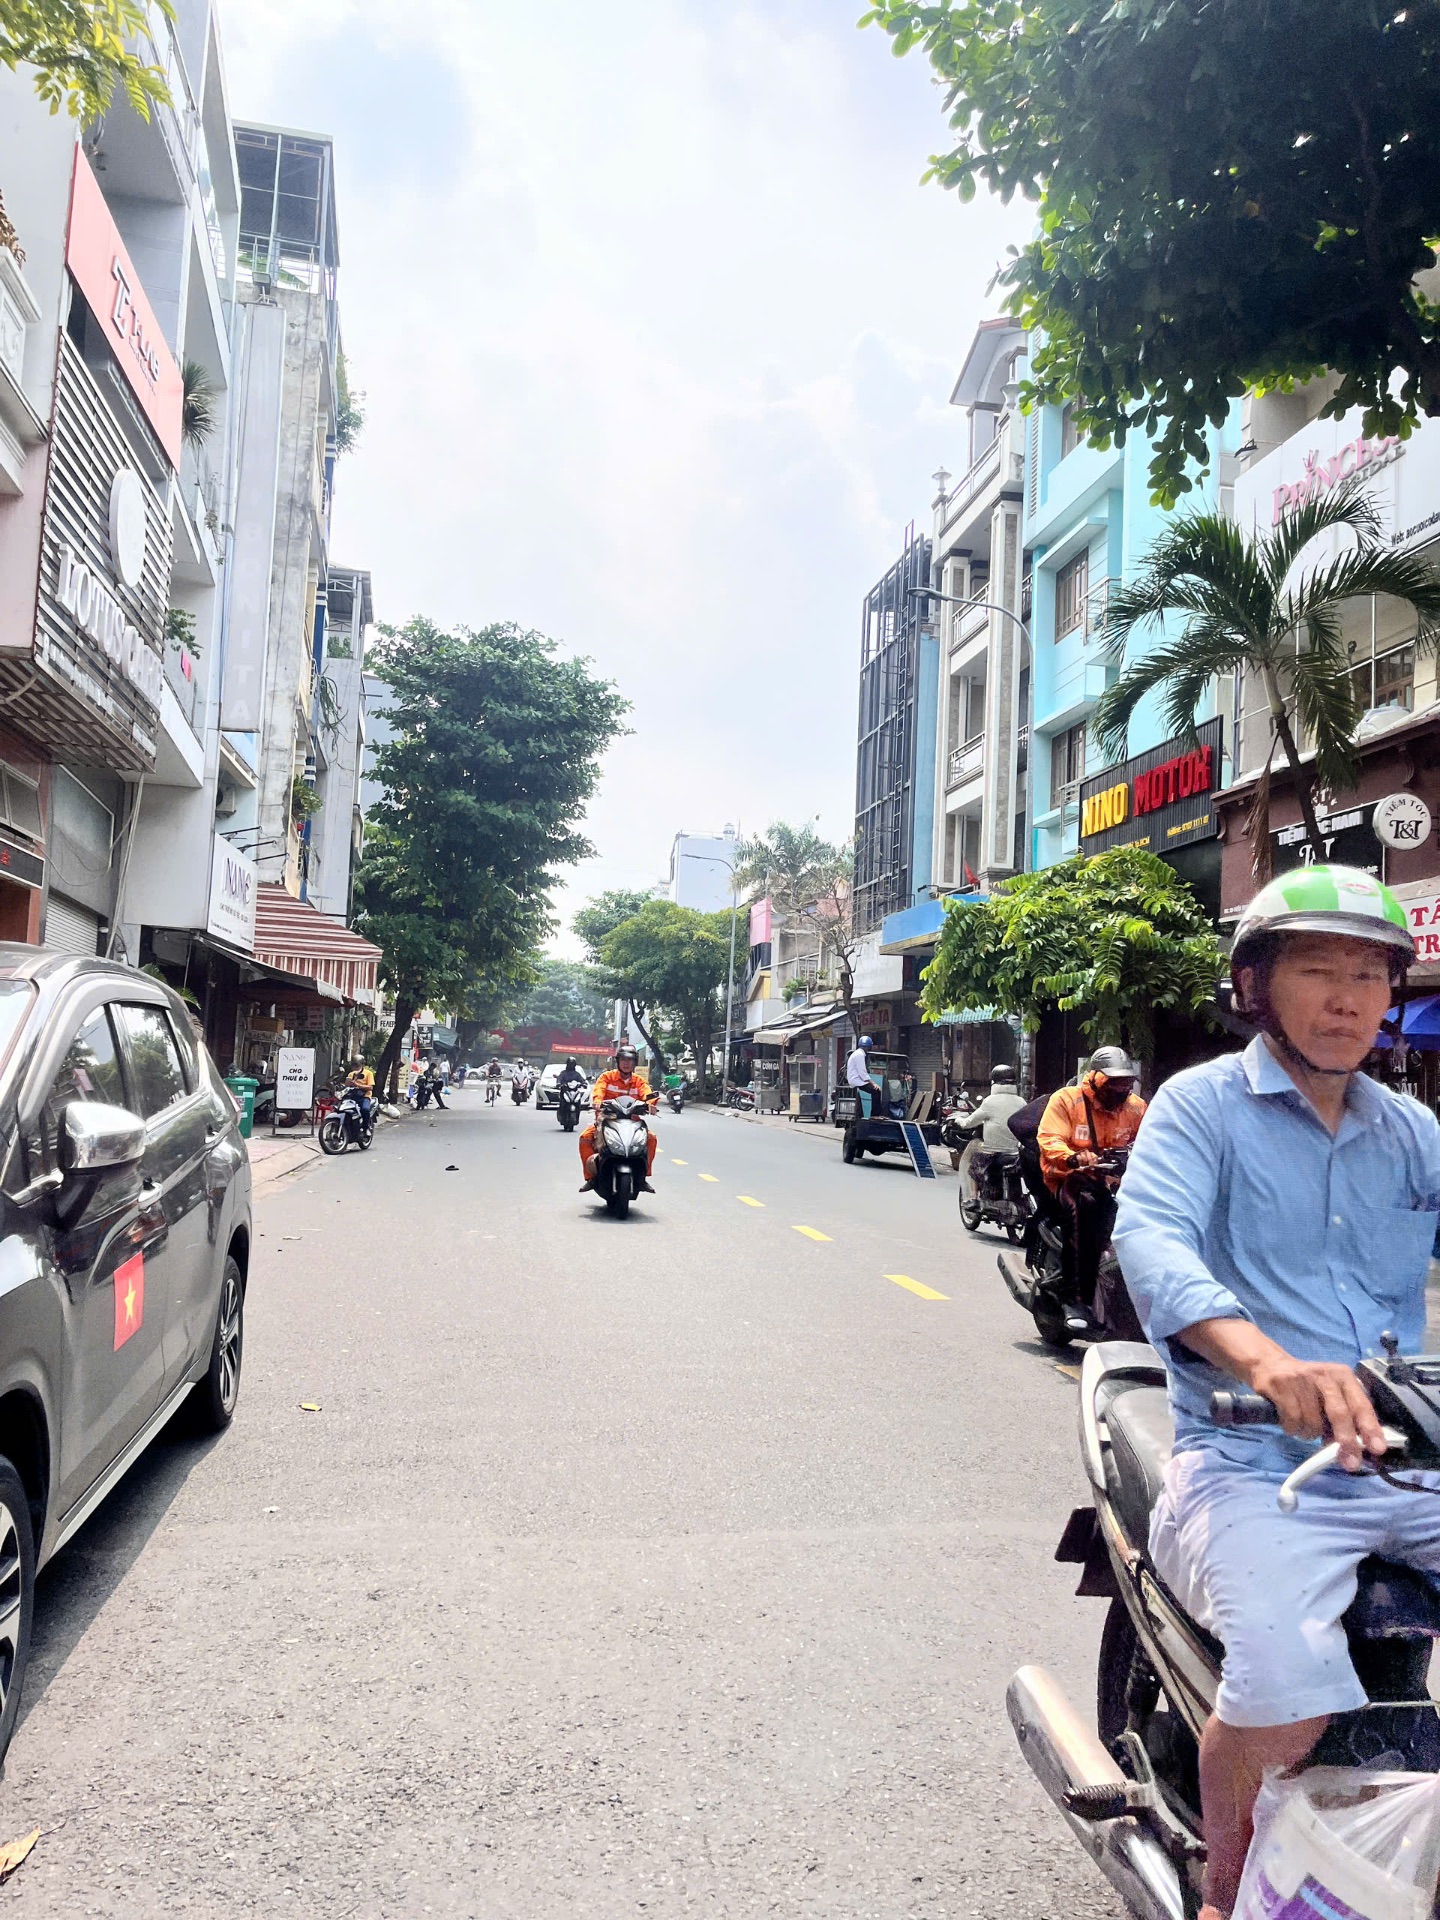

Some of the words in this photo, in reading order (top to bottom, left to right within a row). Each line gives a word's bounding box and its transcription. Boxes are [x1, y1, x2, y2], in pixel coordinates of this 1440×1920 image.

[55, 543, 125, 664] LOTUS
[1081, 783, 1129, 838] NINO
[1133, 744, 1212, 817] MOTOR
[1389, 819, 1423, 840] T&T
